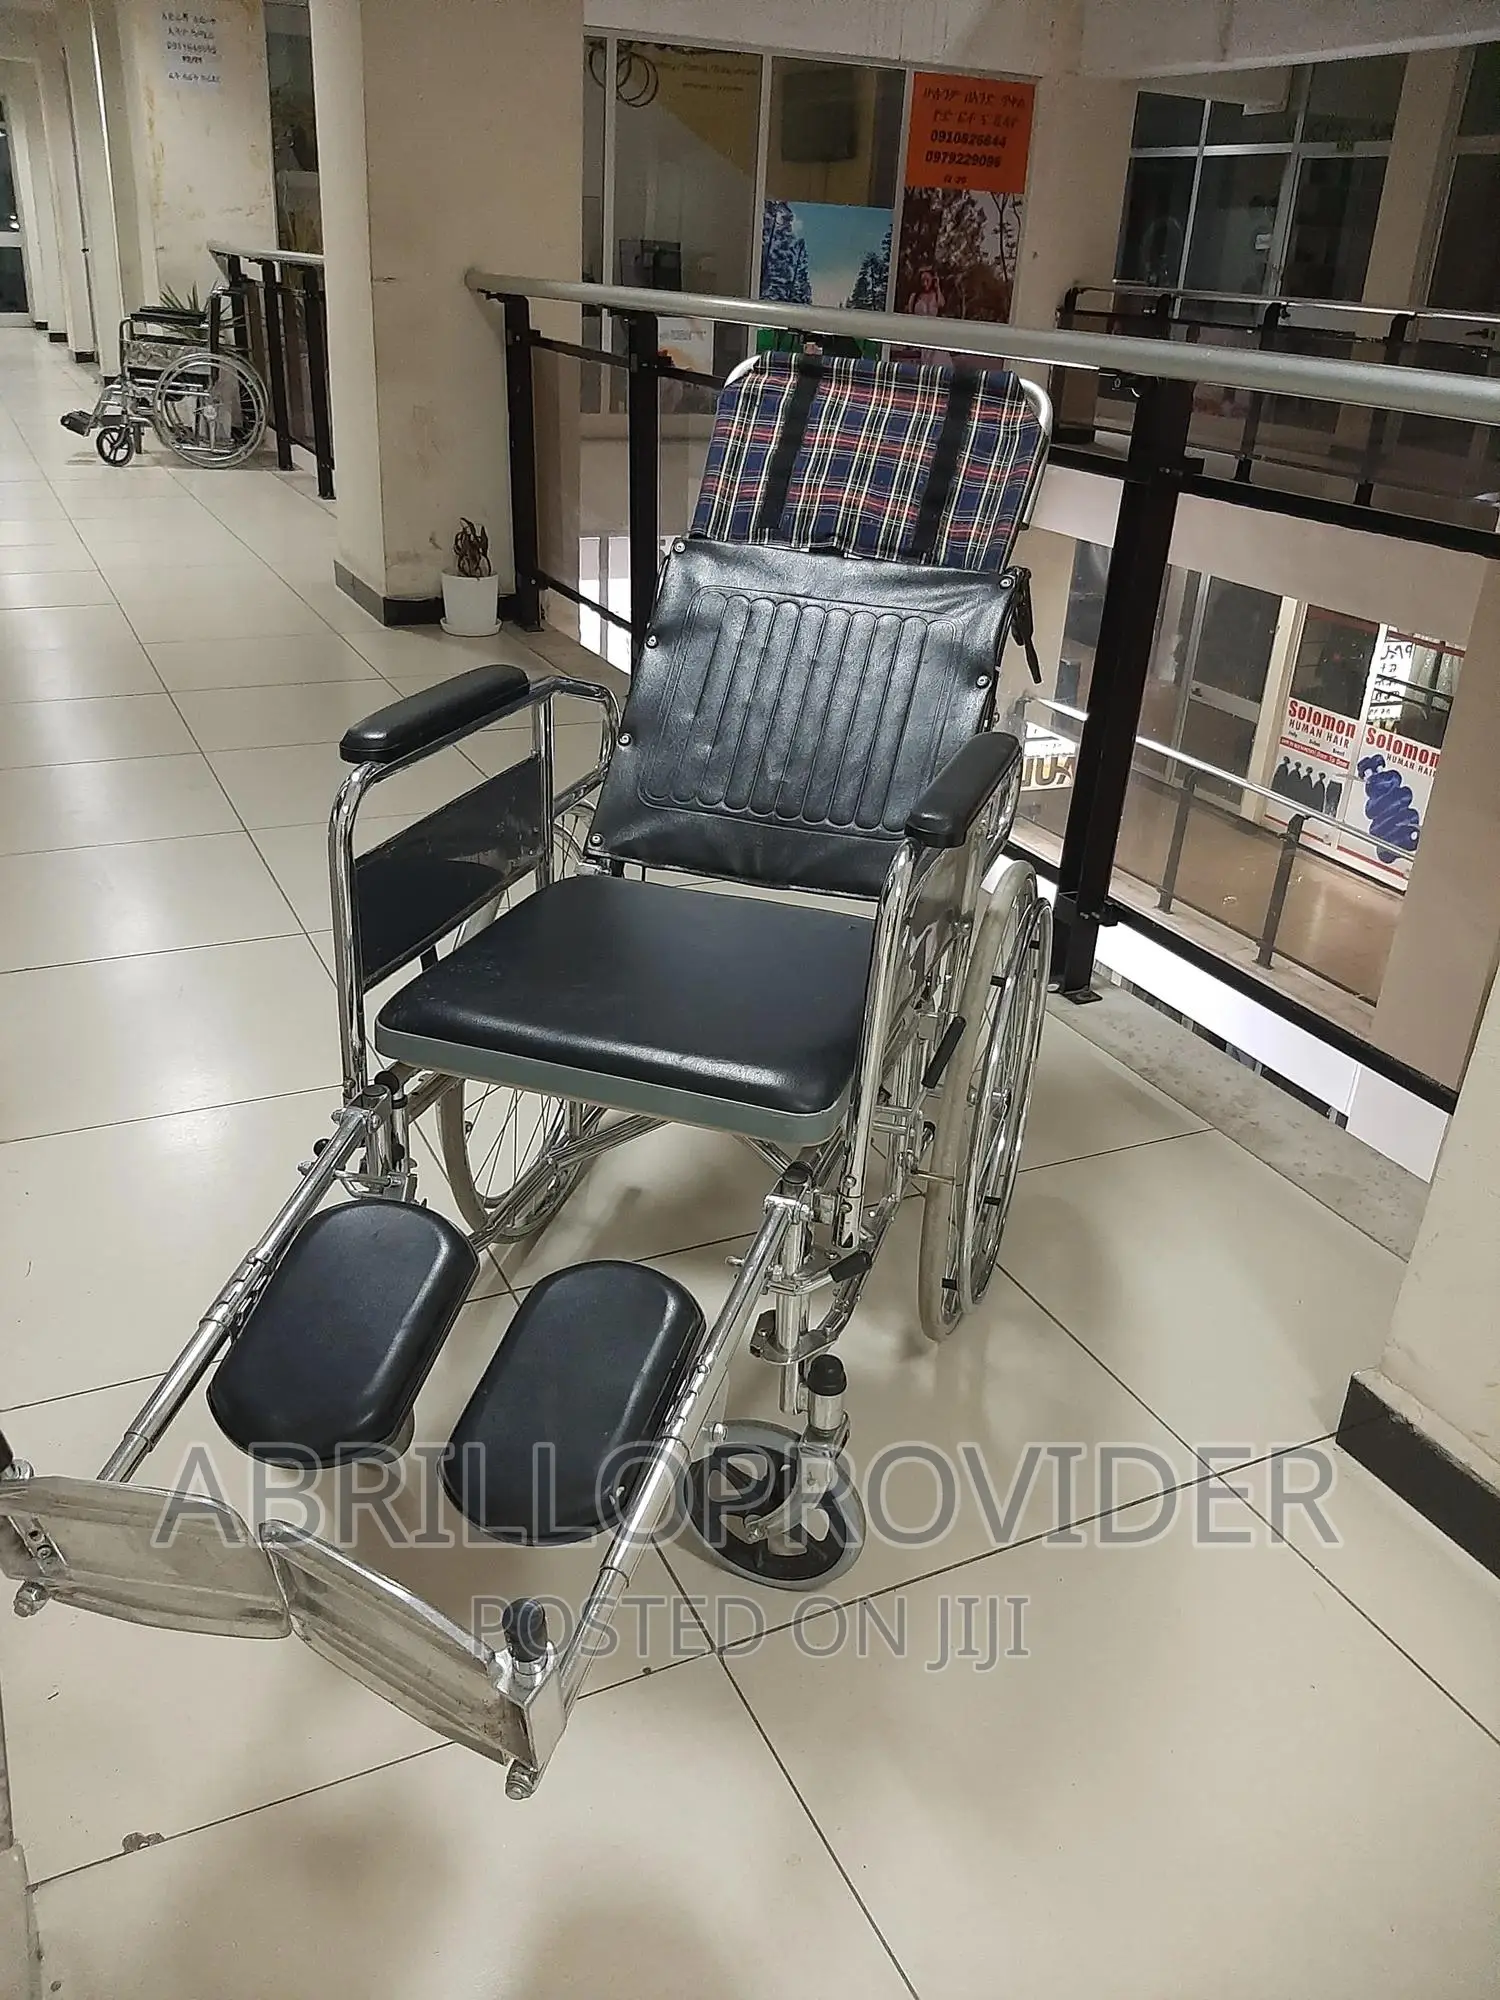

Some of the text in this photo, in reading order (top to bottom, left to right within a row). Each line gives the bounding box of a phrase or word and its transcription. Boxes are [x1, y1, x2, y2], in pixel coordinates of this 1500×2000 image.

[1288, 700, 1357, 740] Solomon
[1288, 718, 1323, 739] HUMAN
[1326, 732, 1350, 749] HAIR
[1366, 727, 1441, 769] Solomon
[1386, 753, 1416, 771] HUMAN
